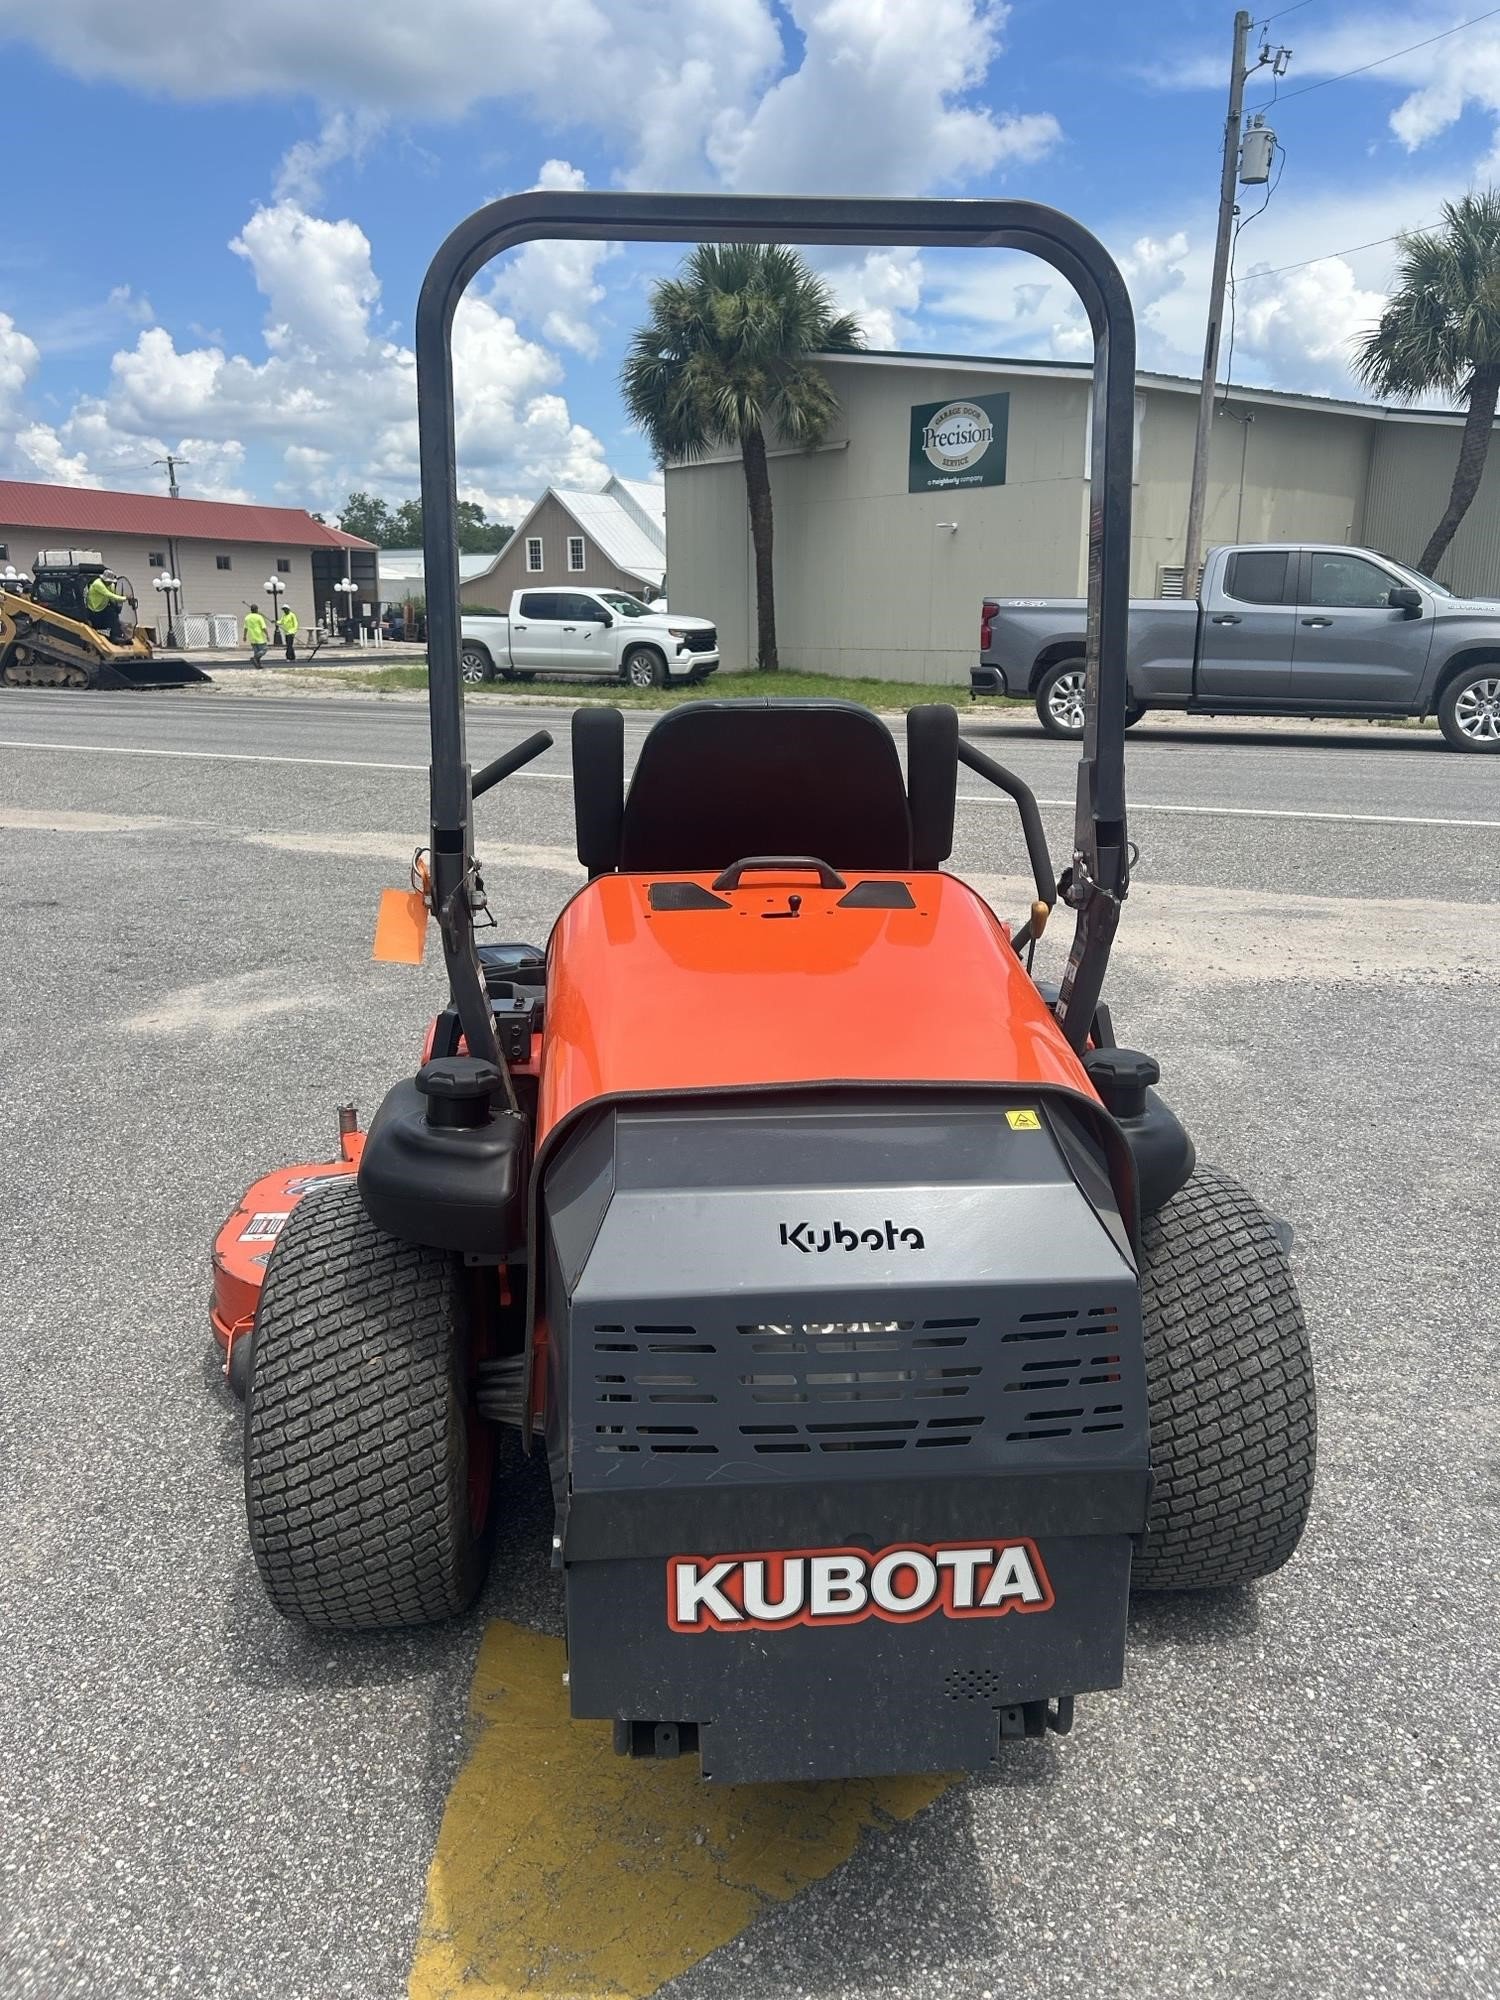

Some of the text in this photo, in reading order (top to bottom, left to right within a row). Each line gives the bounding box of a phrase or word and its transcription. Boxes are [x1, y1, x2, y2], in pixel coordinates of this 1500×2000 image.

[936, 408, 981, 425] GARAGE DOOR
[924, 422, 992, 449] Precision
[942, 457, 969, 467] SERVICE
[779, 1219, 925, 1253] Kubota
[675, 1545, 1044, 1623] KUBOTA
